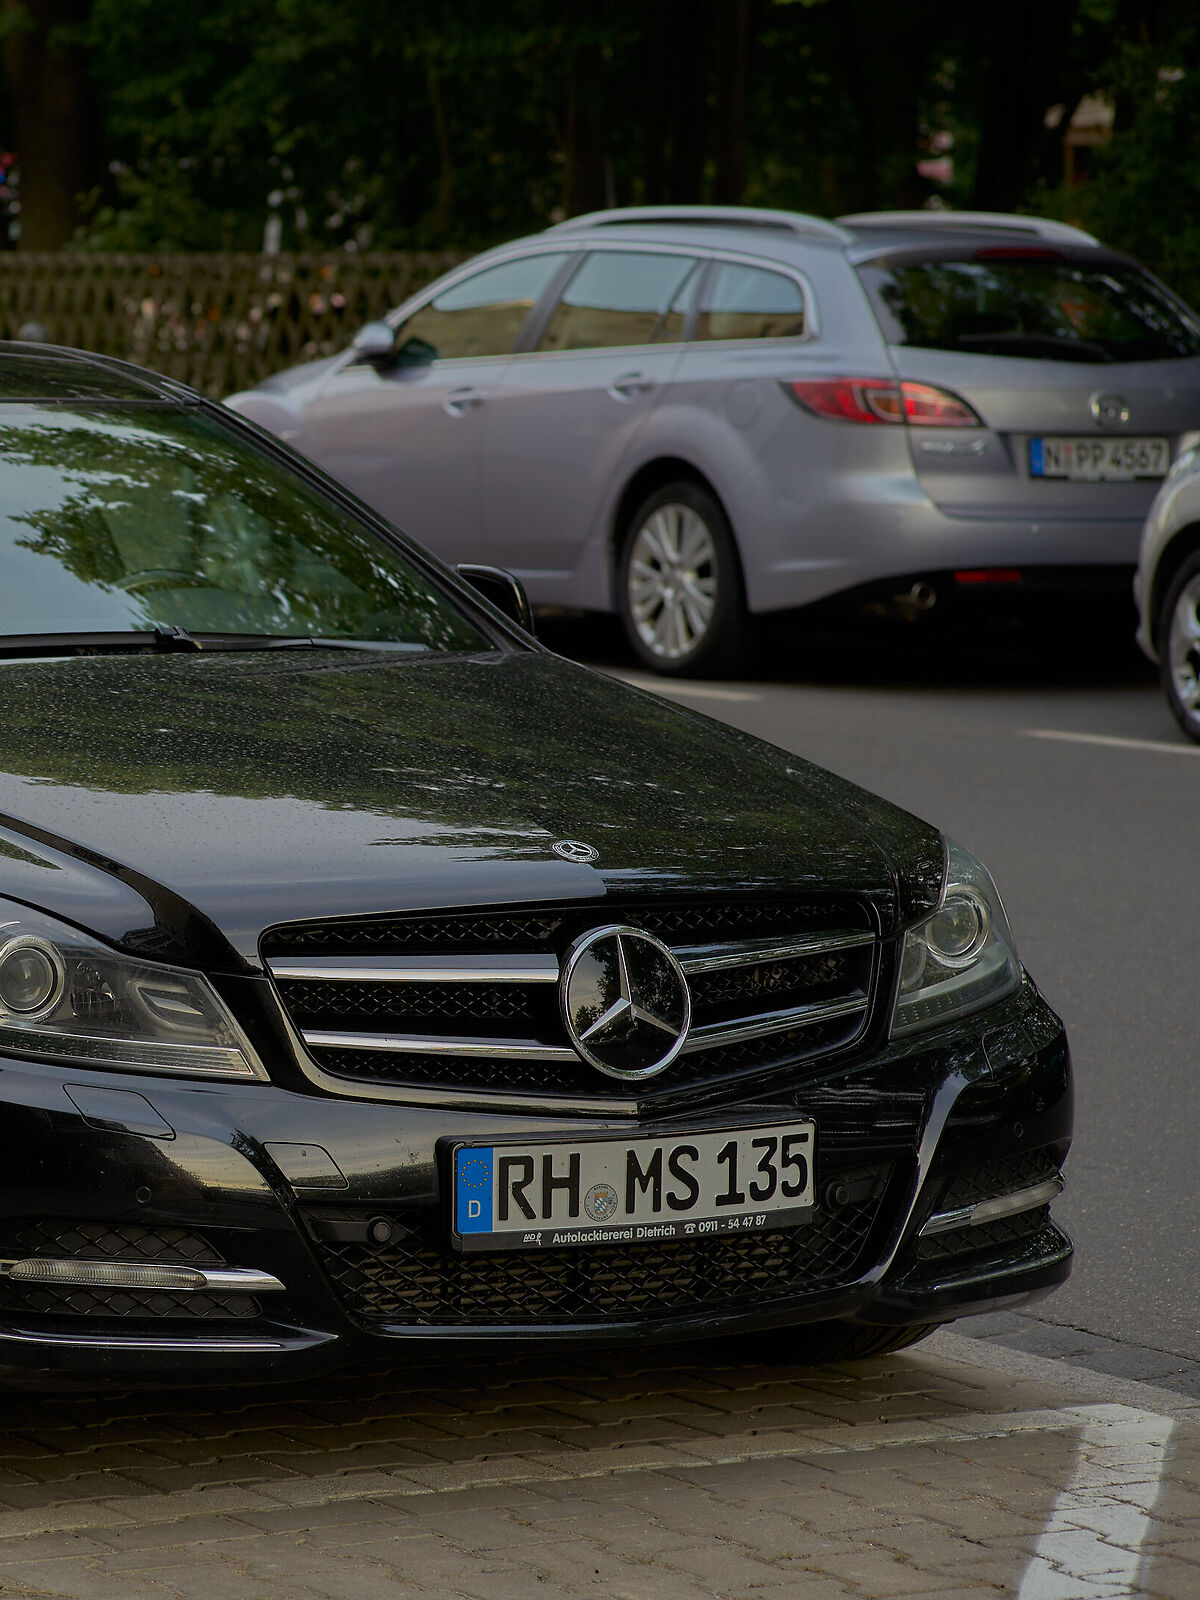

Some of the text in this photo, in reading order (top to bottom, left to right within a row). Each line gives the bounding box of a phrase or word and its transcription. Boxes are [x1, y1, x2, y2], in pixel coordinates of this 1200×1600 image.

[1046, 442, 1163, 470] N PP 4567
[498, 1152, 581, 1221] RH
[625, 1145, 700, 1214] MS
[714, 1132, 809, 1207] 135
[468, 1200, 481, 1218] D
[552, 1227, 634, 1244] Autolackiererei
[636, 1224, 676, 1238] Dietrich
[698, 1220, 718, 1233] 0911
[727, 1217, 740, 1230] 54
[742, 1215, 754, 1227] 47
[755, 1214, 767, 1226] 87
